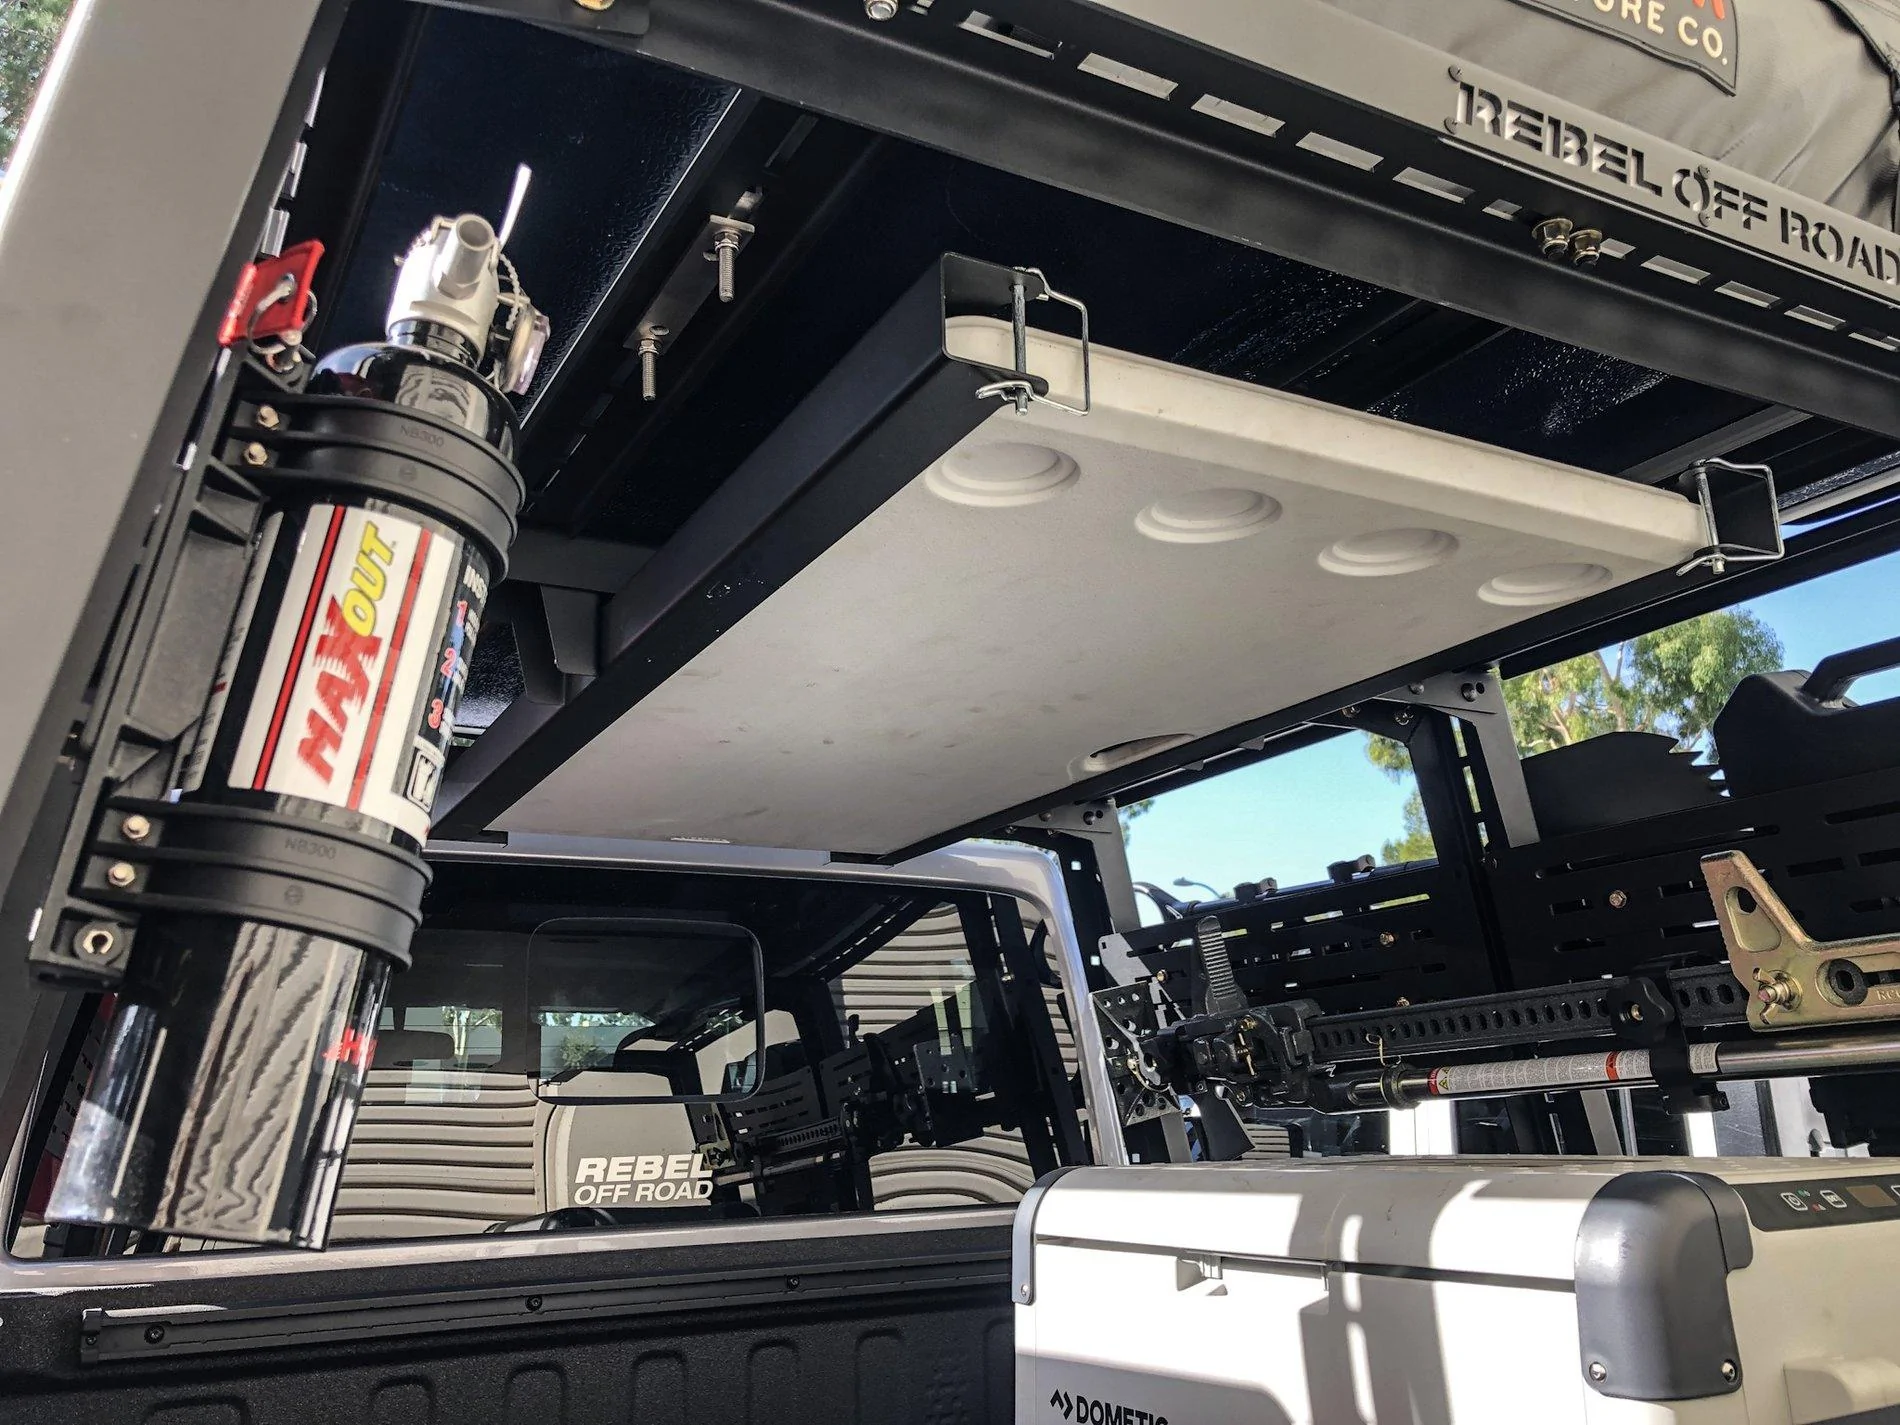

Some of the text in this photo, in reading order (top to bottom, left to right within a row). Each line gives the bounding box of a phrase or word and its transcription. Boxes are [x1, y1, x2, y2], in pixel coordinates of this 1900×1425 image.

[1678, 16, 1728, 66] CO.
[1456, 81, 1900, 286] REBEL OFF ROAD
[574, 1153, 714, 1184] REBEL
[573, 1180, 714, 1205] OFF ROAD
